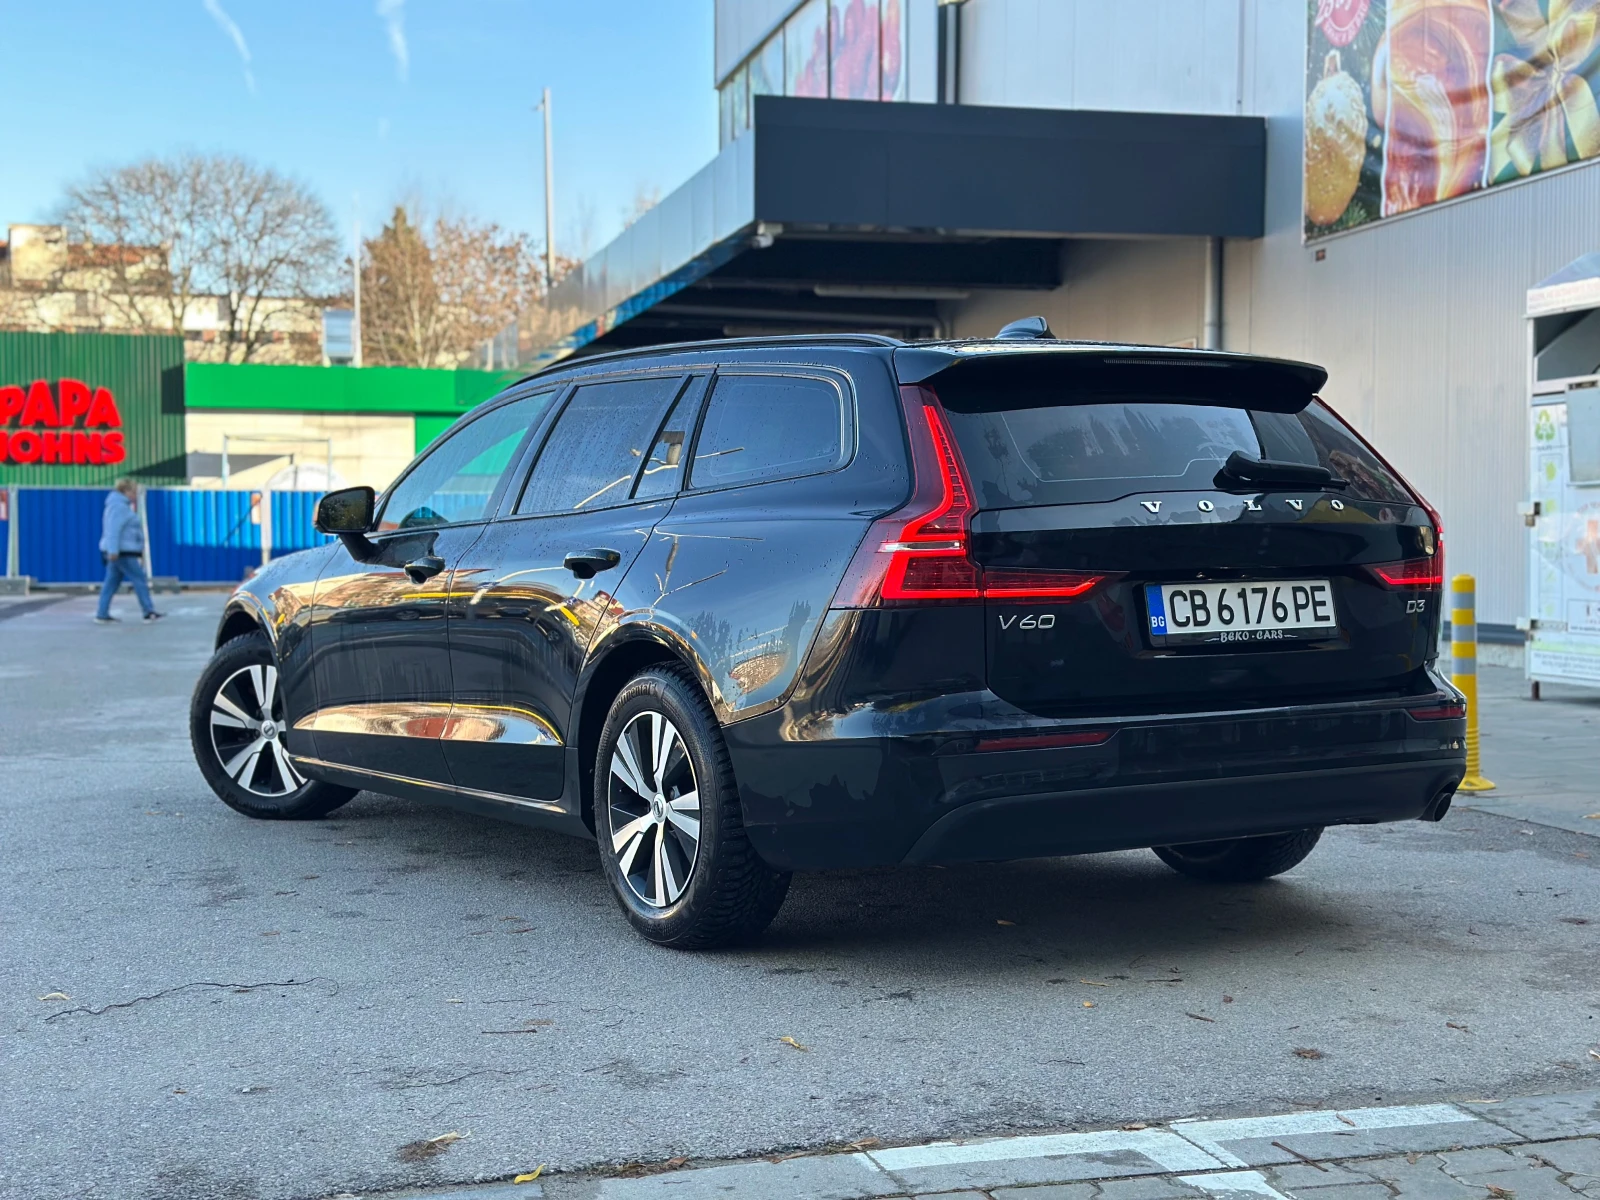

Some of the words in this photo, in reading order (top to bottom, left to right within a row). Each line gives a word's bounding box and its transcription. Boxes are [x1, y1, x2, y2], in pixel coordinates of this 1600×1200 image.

[0, 378, 122, 427] PAPA
[1140, 499, 1345, 514] VOLVO
[1405, 599, 1426, 614] D3
[1150, 615, 1165, 628] BG
[1219, 631, 1250, 643] BEKO
[1255, 629, 1284, 640] CARS
